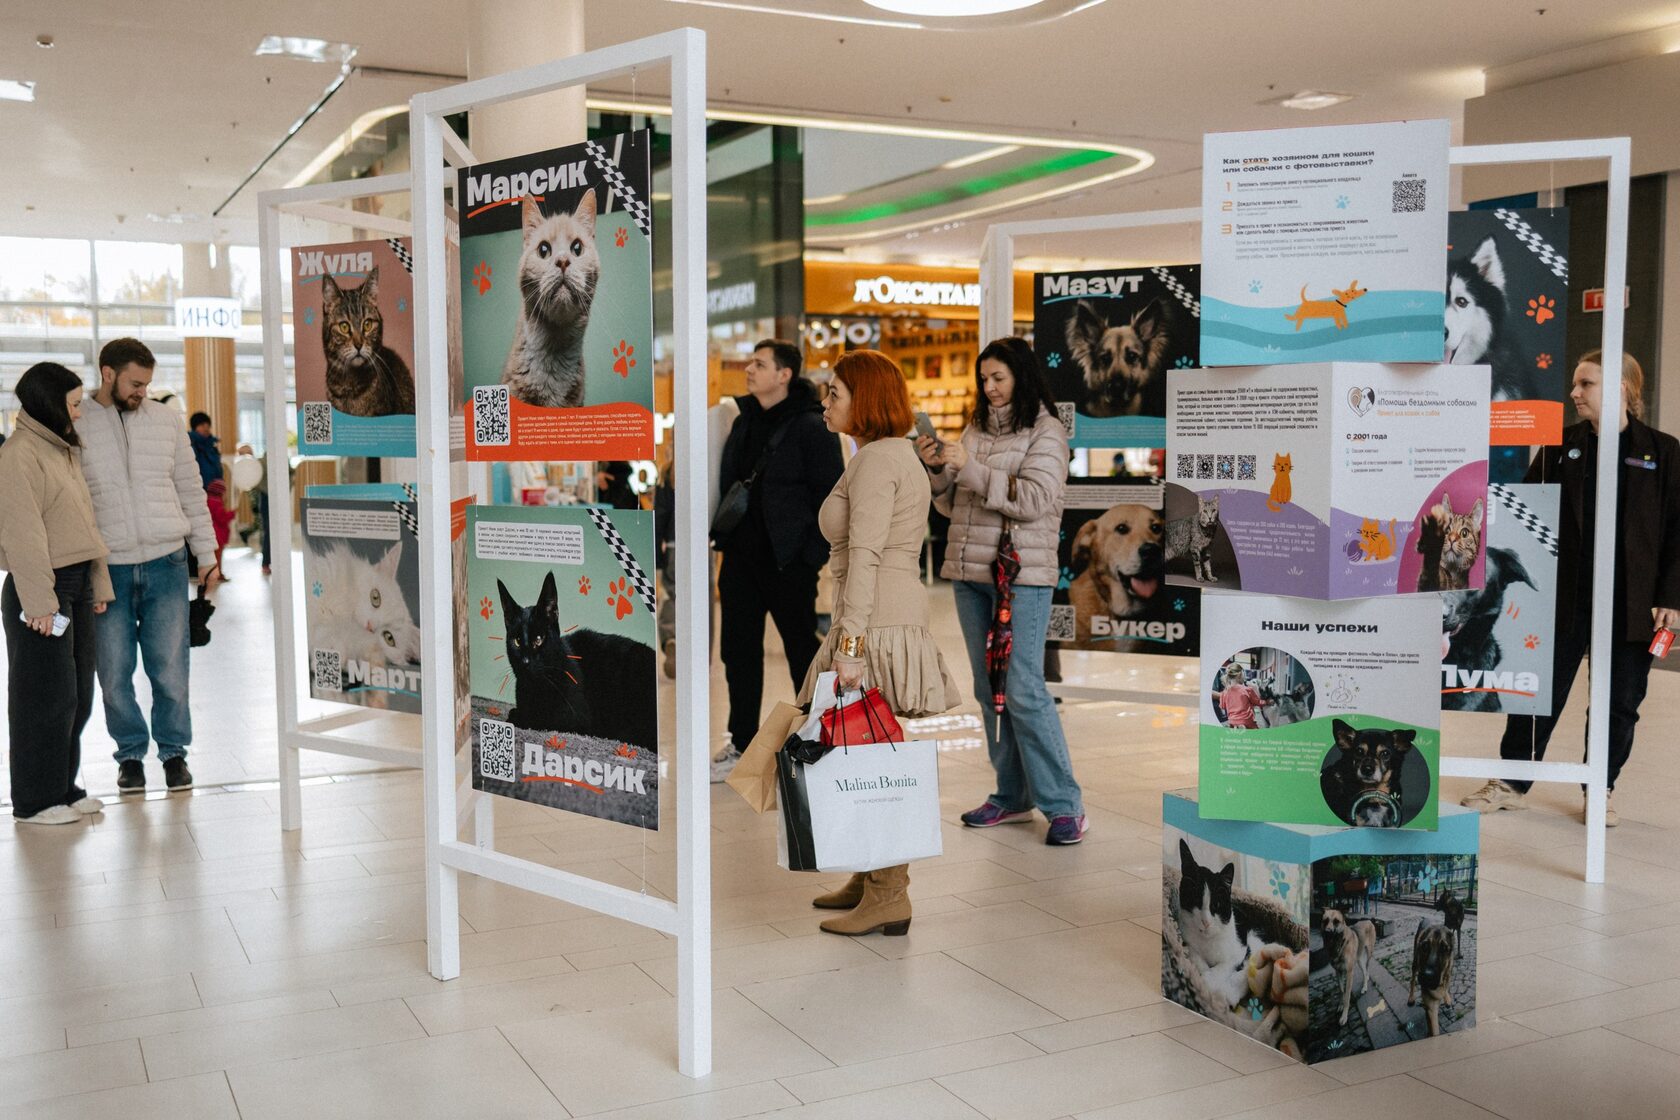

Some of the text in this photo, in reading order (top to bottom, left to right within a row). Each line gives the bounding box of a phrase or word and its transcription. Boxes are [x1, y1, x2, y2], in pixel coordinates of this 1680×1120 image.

[1242, 156, 1269, 164] стать
[1272, 153, 1319, 162] хозяином
[1322, 151, 1340, 160] для
[1343, 150, 1375, 158] кошки
[1243, 164, 1283, 172] собачки
[1293, 159, 1374, 170] фотовыставки?
[467, 160, 588, 206] Марсик
[1225, 181, 1231, 192] 1
[1221, 201, 1233, 212] 2
[1221, 224, 1232, 235] 3
[299, 250, 373, 276] Жуля
[1043, 275, 1143, 298] Мазут
[1409, 398, 1446, 406] бездомным
[1091, 615, 1186, 643] Букер
[1261, 620, 1378, 634] Наши успехи
[522, 742, 647, 795] Дарсик
[835, 774, 918, 793] Malina Bonita
